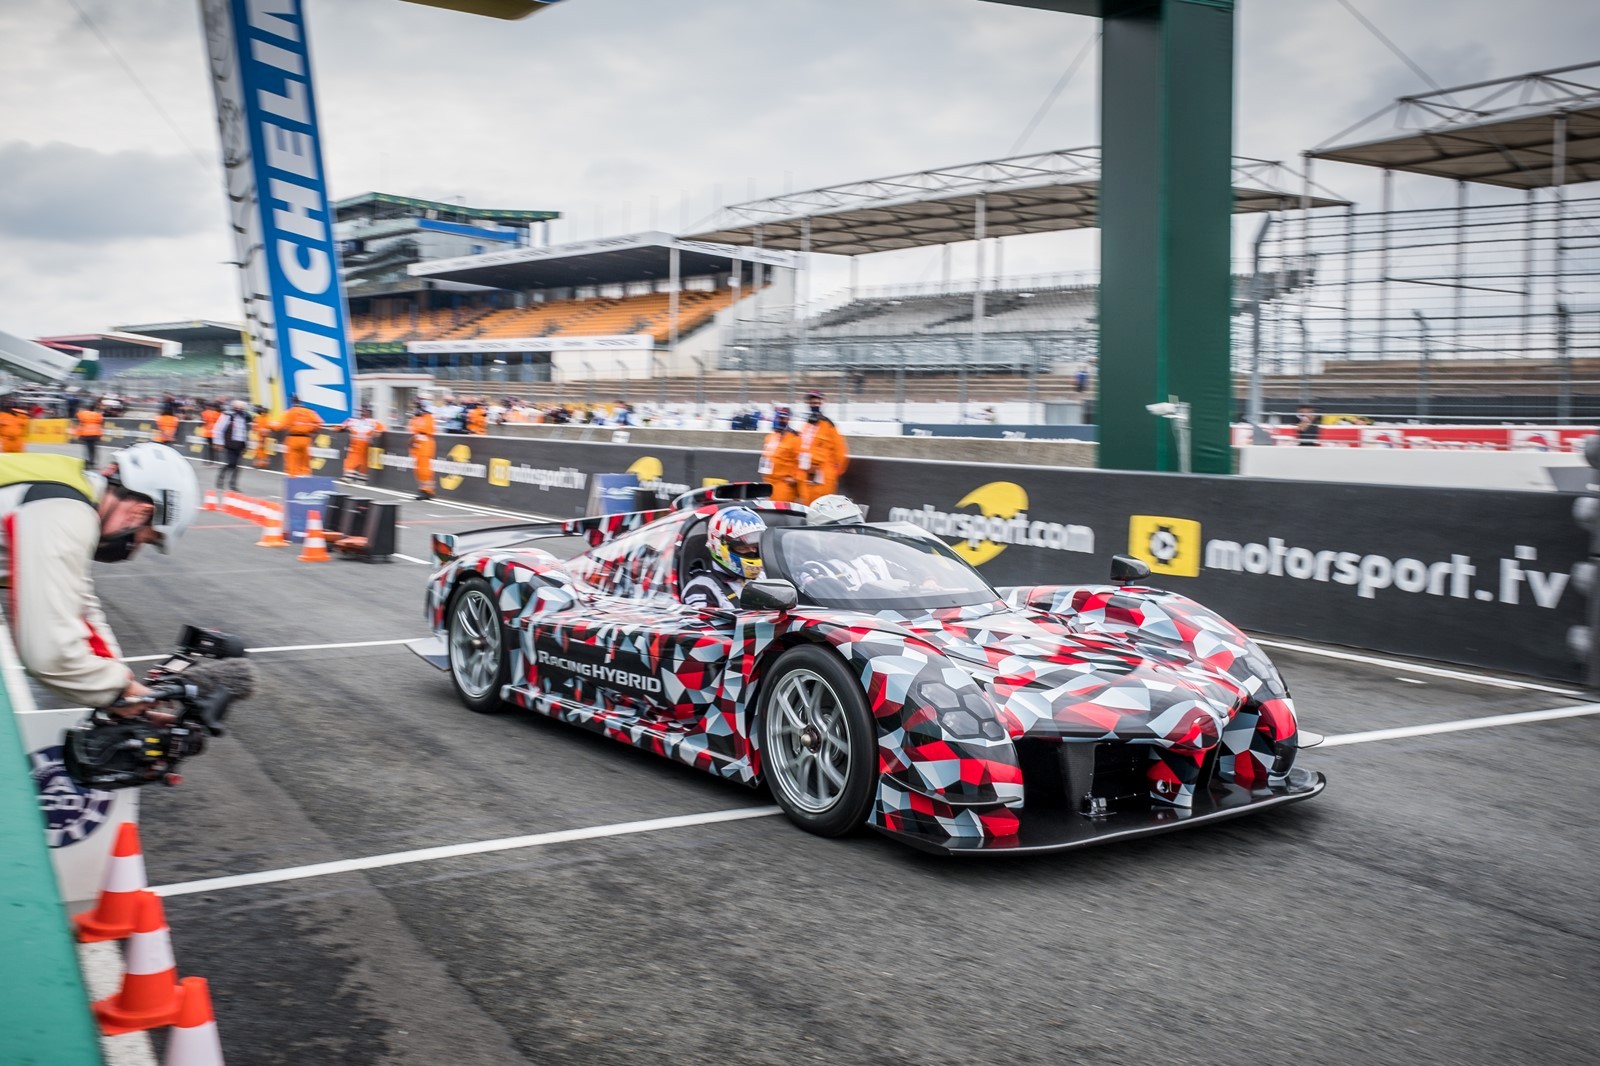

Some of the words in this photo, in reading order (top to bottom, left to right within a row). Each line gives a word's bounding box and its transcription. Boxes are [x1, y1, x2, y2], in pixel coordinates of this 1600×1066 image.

[245, 0, 348, 411] MICHELIN
[889, 504, 1094, 553] motorsport.com
[1205, 537, 1570, 608] motorsport.tv
